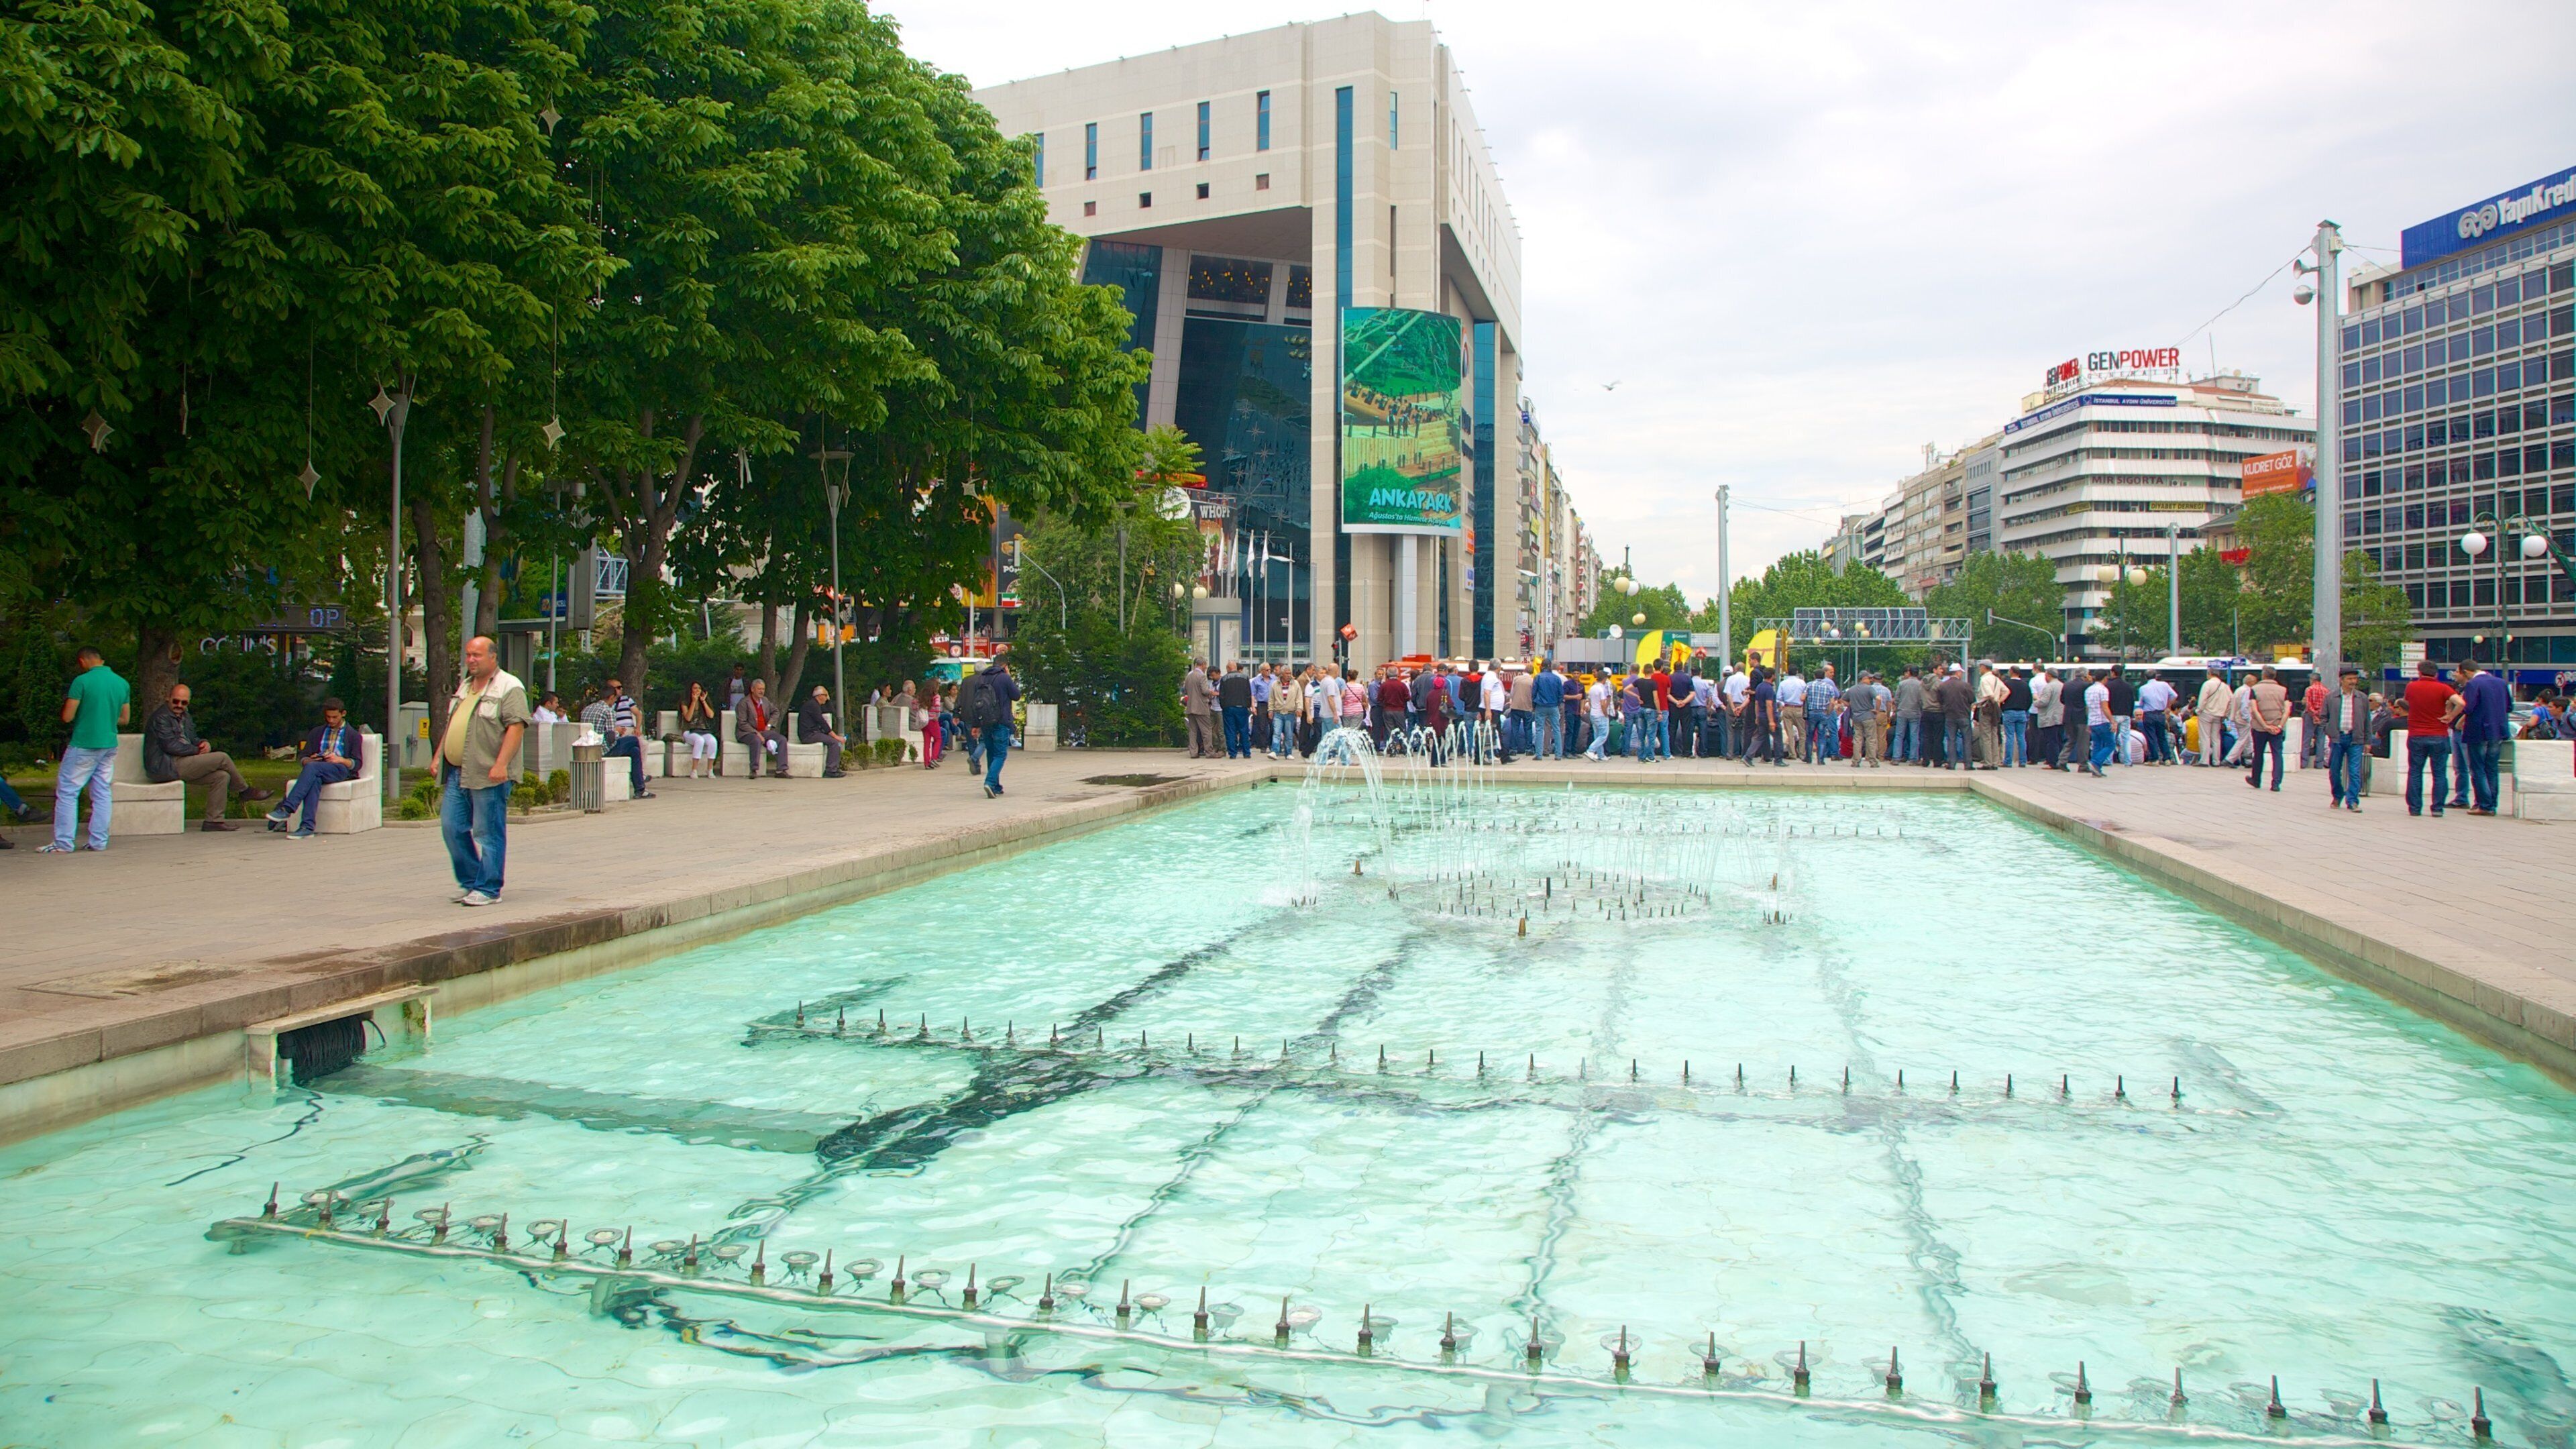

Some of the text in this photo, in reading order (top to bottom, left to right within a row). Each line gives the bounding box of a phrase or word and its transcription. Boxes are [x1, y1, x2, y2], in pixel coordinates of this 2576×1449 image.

[2497, 173, 2576, 225] YapıKred
[2088, 347, 2180, 371] GENPOWER
[2047, 358, 2079, 387] GENPOWER
[2244, 455, 2293, 476] KUDRET GÖZ
[1368, 488, 1452, 513] ANKAPARK
[1368, 511, 1403, 521] Ağustos'ta
